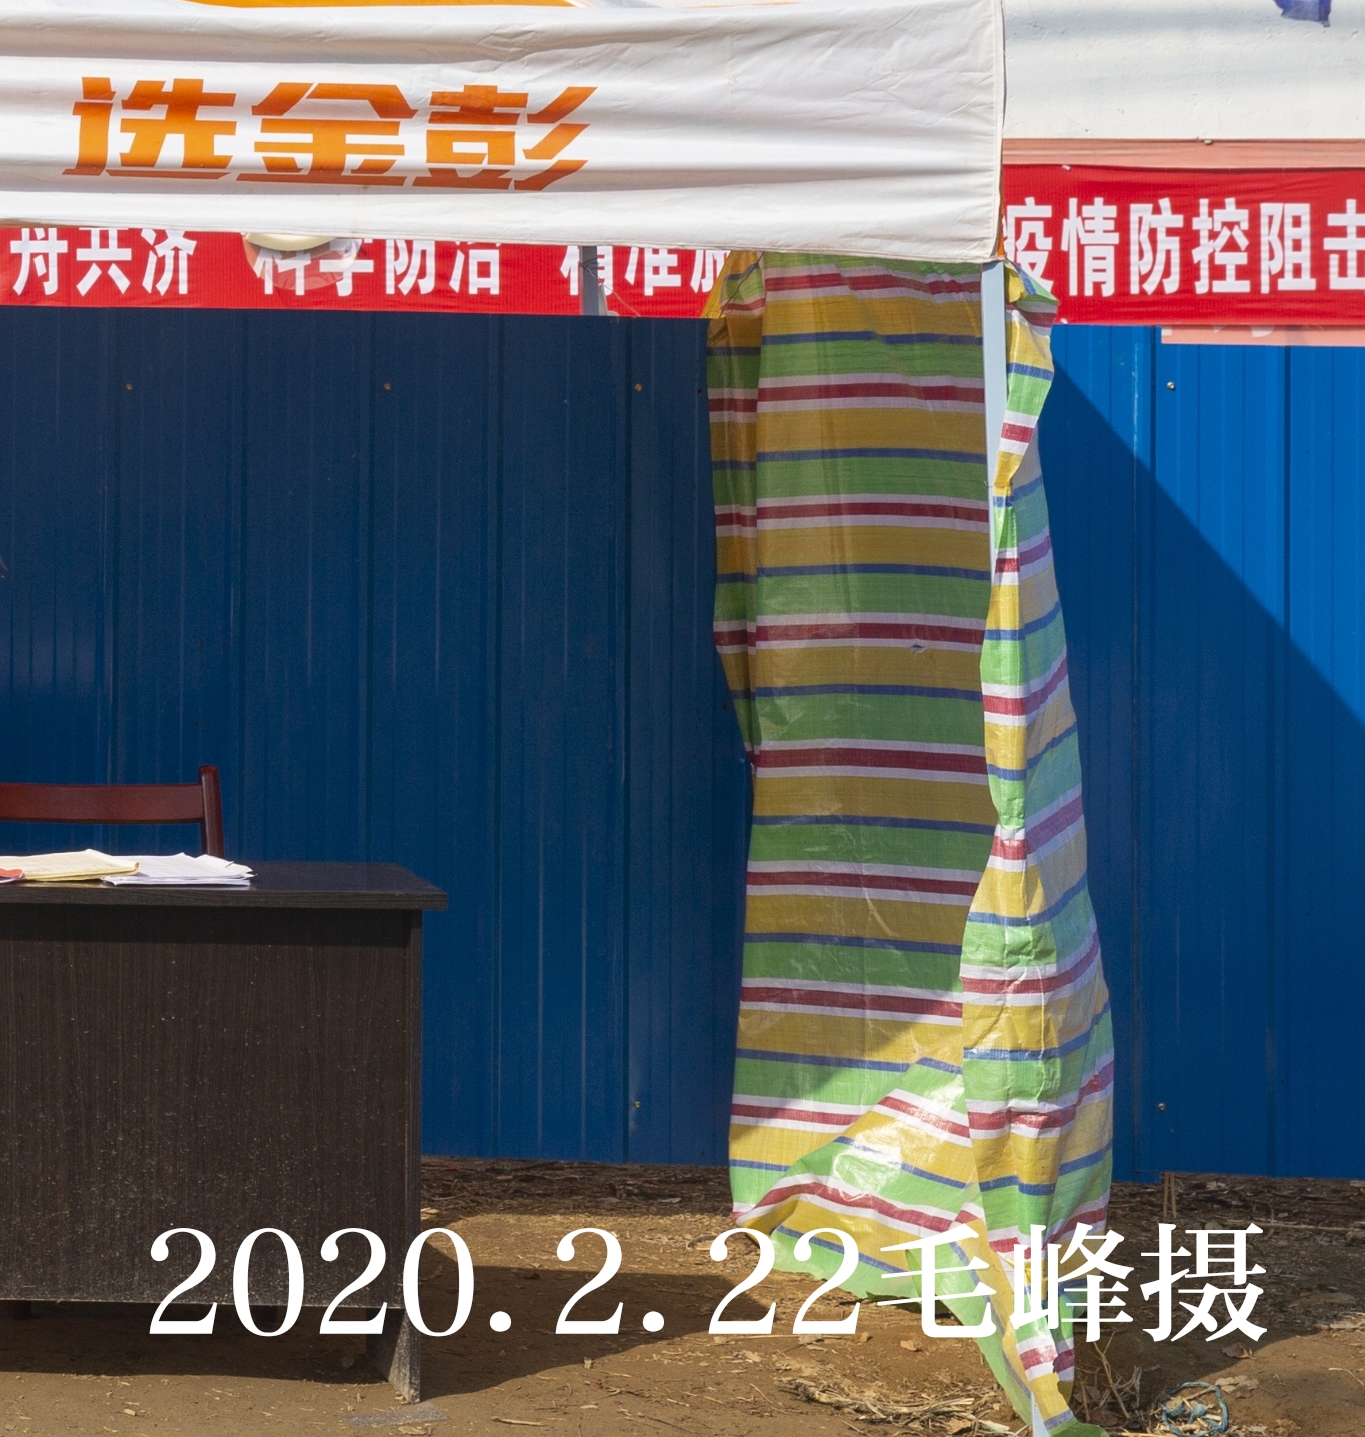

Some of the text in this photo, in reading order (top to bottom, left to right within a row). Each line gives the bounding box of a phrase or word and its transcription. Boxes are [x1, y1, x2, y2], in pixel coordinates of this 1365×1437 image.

[61, 75, 598, 192] 选金彭
[1003, 197, 1365, 298] 疫情防控阻击
